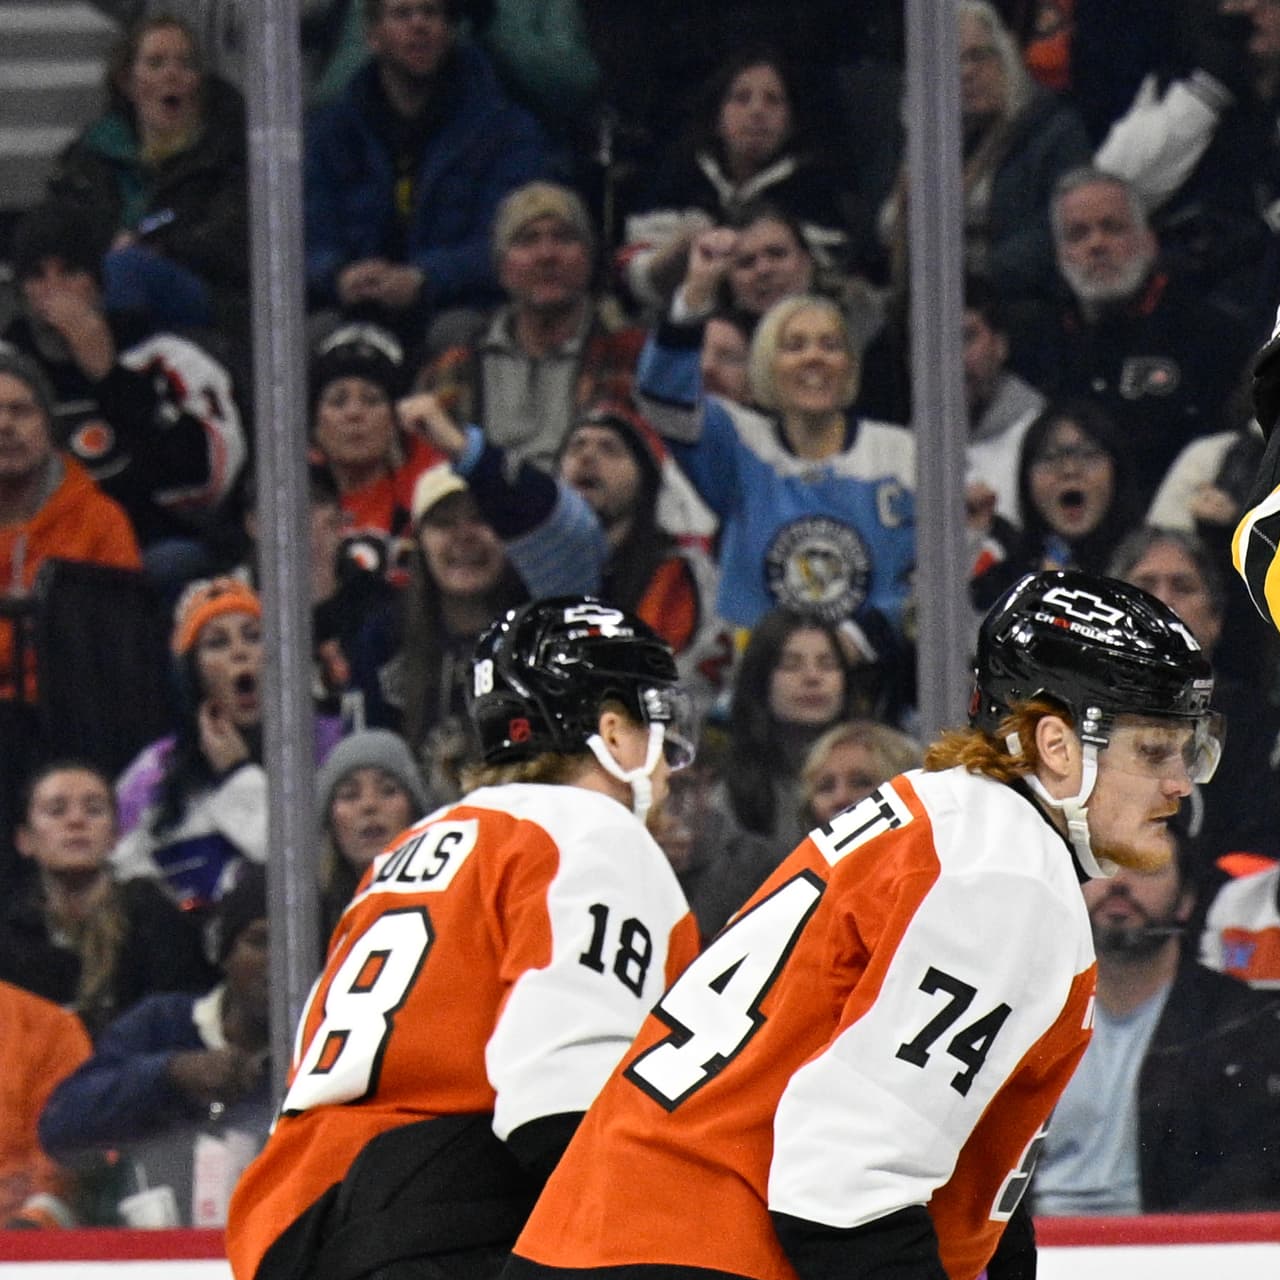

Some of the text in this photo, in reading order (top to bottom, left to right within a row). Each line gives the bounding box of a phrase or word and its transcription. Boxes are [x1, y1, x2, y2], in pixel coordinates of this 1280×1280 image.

[281, 906, 434, 1117] 8
[579, 903, 652, 998] 18
[622, 868, 828, 1114] 4
[895, 966, 1013, 1098] 74
